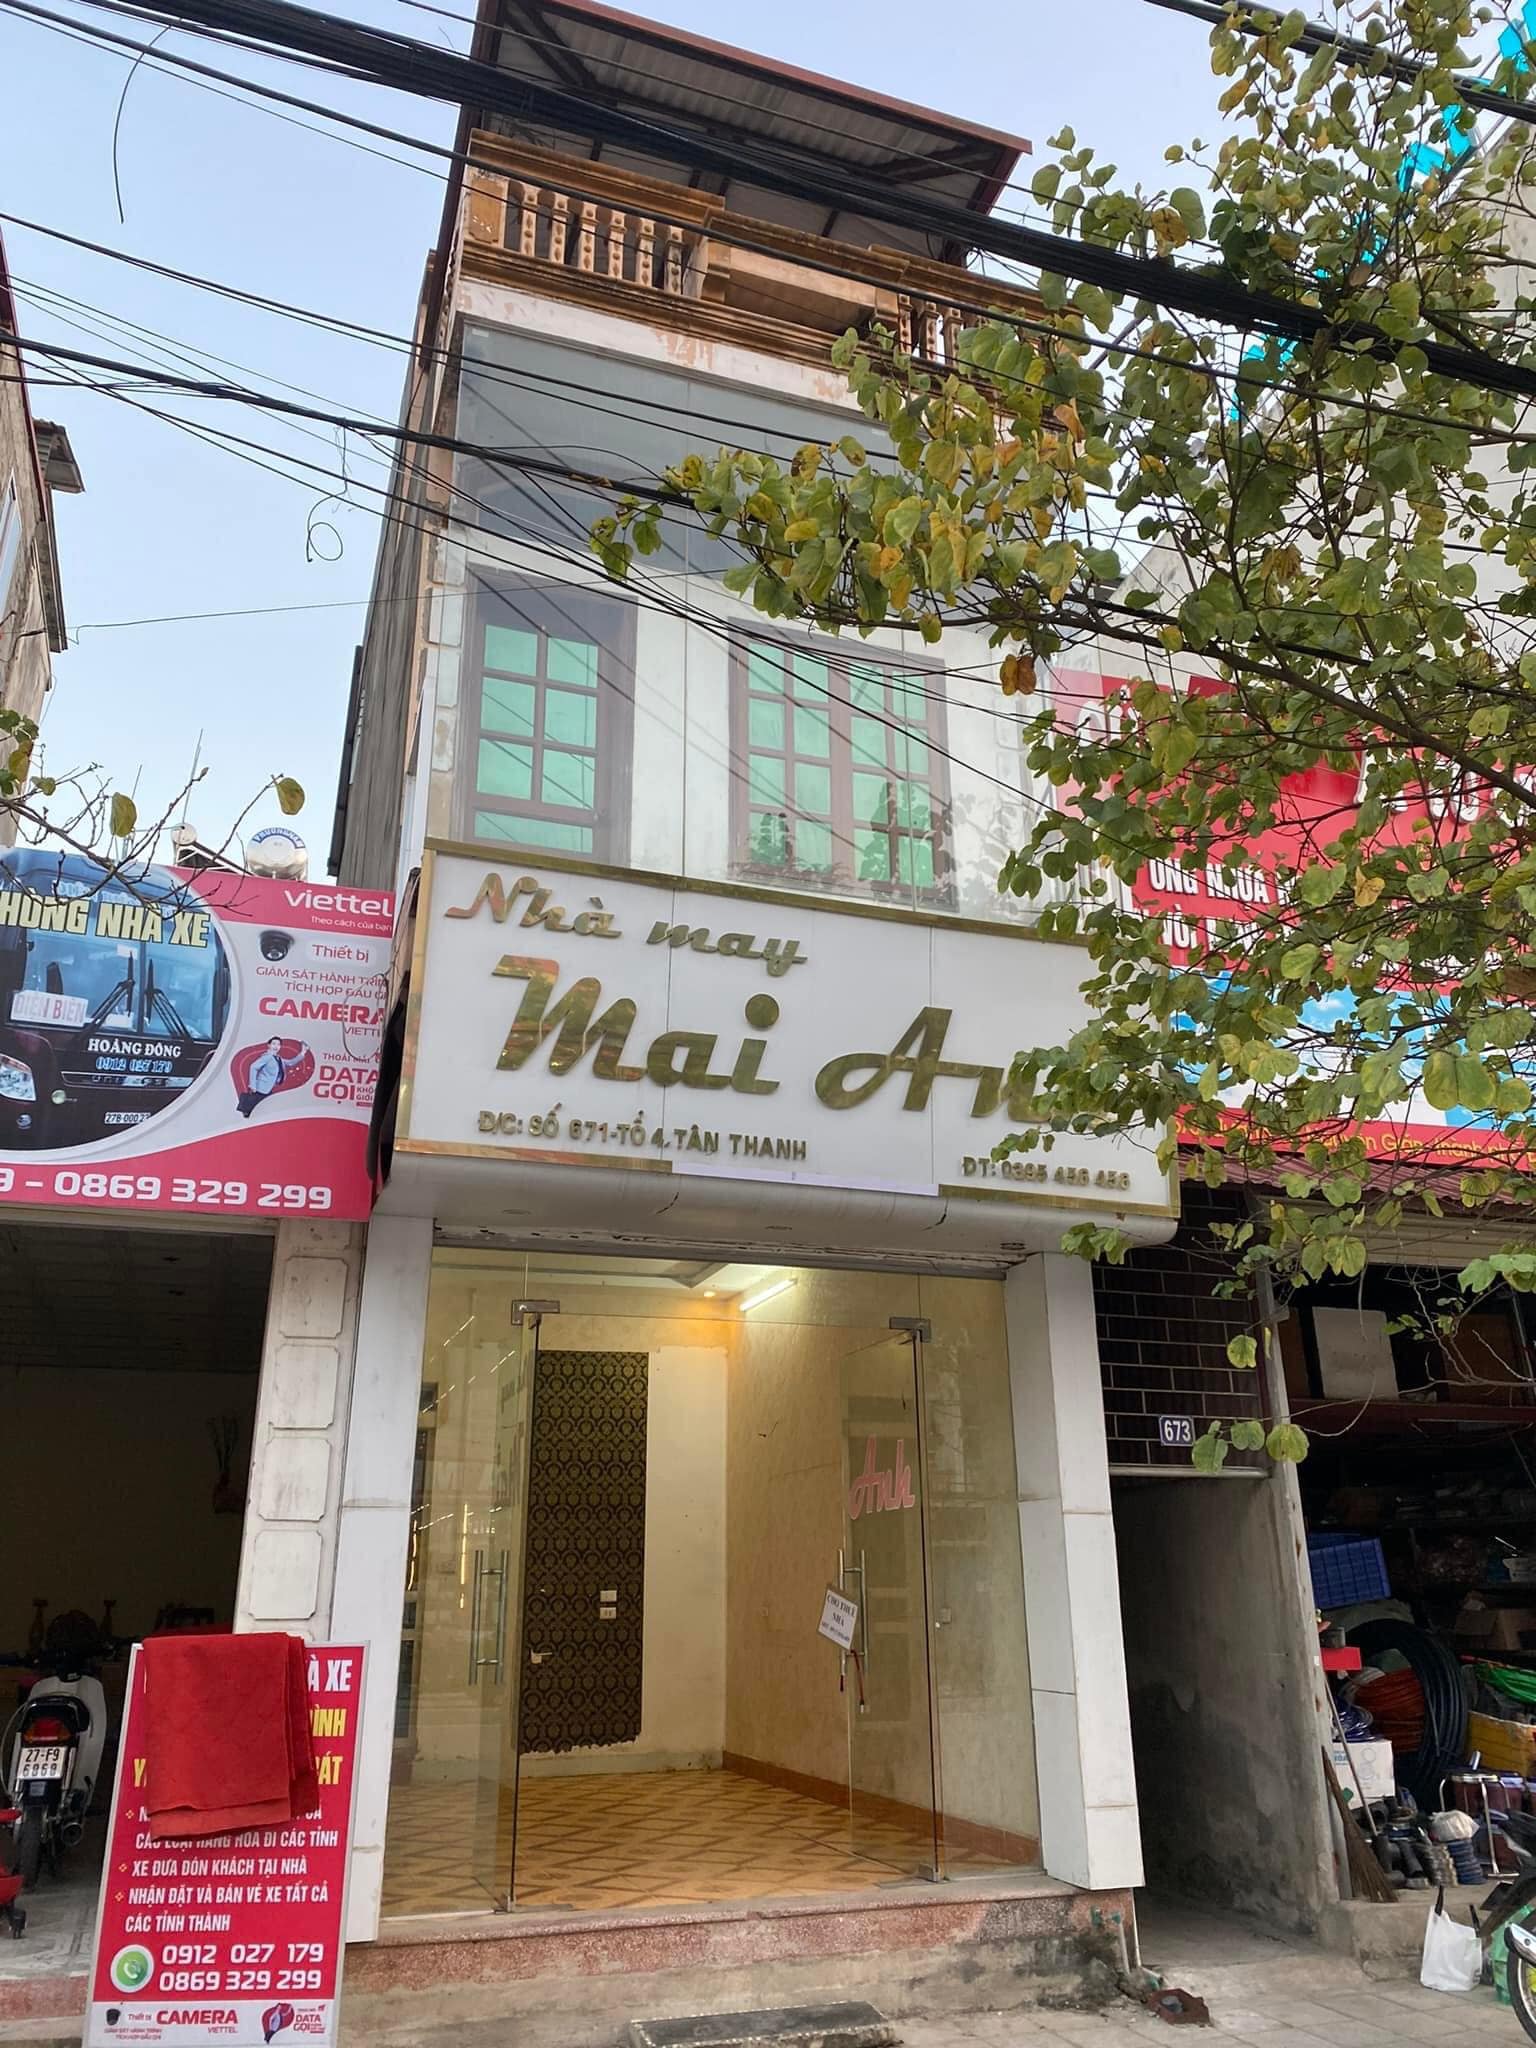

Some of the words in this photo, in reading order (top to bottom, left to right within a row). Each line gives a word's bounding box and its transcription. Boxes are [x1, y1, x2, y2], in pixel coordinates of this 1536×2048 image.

[284, 889, 393, 918] viettel
[96, 901, 163, 943] NHÀ
[169, 911, 210, 947] XE
[444, 871, 622, 939] Nhà
[646, 920, 808, 977] may
[312, 944, 352, 960] Thiết
[356, 949, 369, 963] bị
[491, 953, 780, 1096] Mai
[320, 1065, 379, 1084] DATA
[313, 1083, 355, 1104] GỌI
[528, 1102, 562, 1138] SỐ
[729, 1133, 807, 1161] THANH
[54, 1171, 161, 1200] 0869
[171, 1177, 248, 1205] 329
[257, 1183, 332, 1210] 299
[1164, 1419, 1191, 1442] 673
[325, 1659, 353, 1692] XE
[311, 1704, 347, 1737] ÌNH
[316, 1751, 344, 1785] ÁT
[132, 1860, 149, 1877] XE
[211, 1856, 254, 1876] KHÁCH
[258, 1858, 277, 1878] TẠI
[281, 1855, 307, 1875] NHÀ
[266, 1885, 282, 1903] XE
[125, 1910, 152, 1933] CÁC
[188, 1910, 231, 1932] THÀNH
[162, 1944, 217, 1965] 0912
[230, 1943, 275, 1964] 027
[287, 1943, 324, 1964] 179
[158, 1971, 220, 1992] 0869
[225, 1970, 271, 1991] 329
[276, 1969, 322, 1991] 299
[156, 2009, 239, 2025] CAMERA
[295, 2013, 321, 2023] DATA
